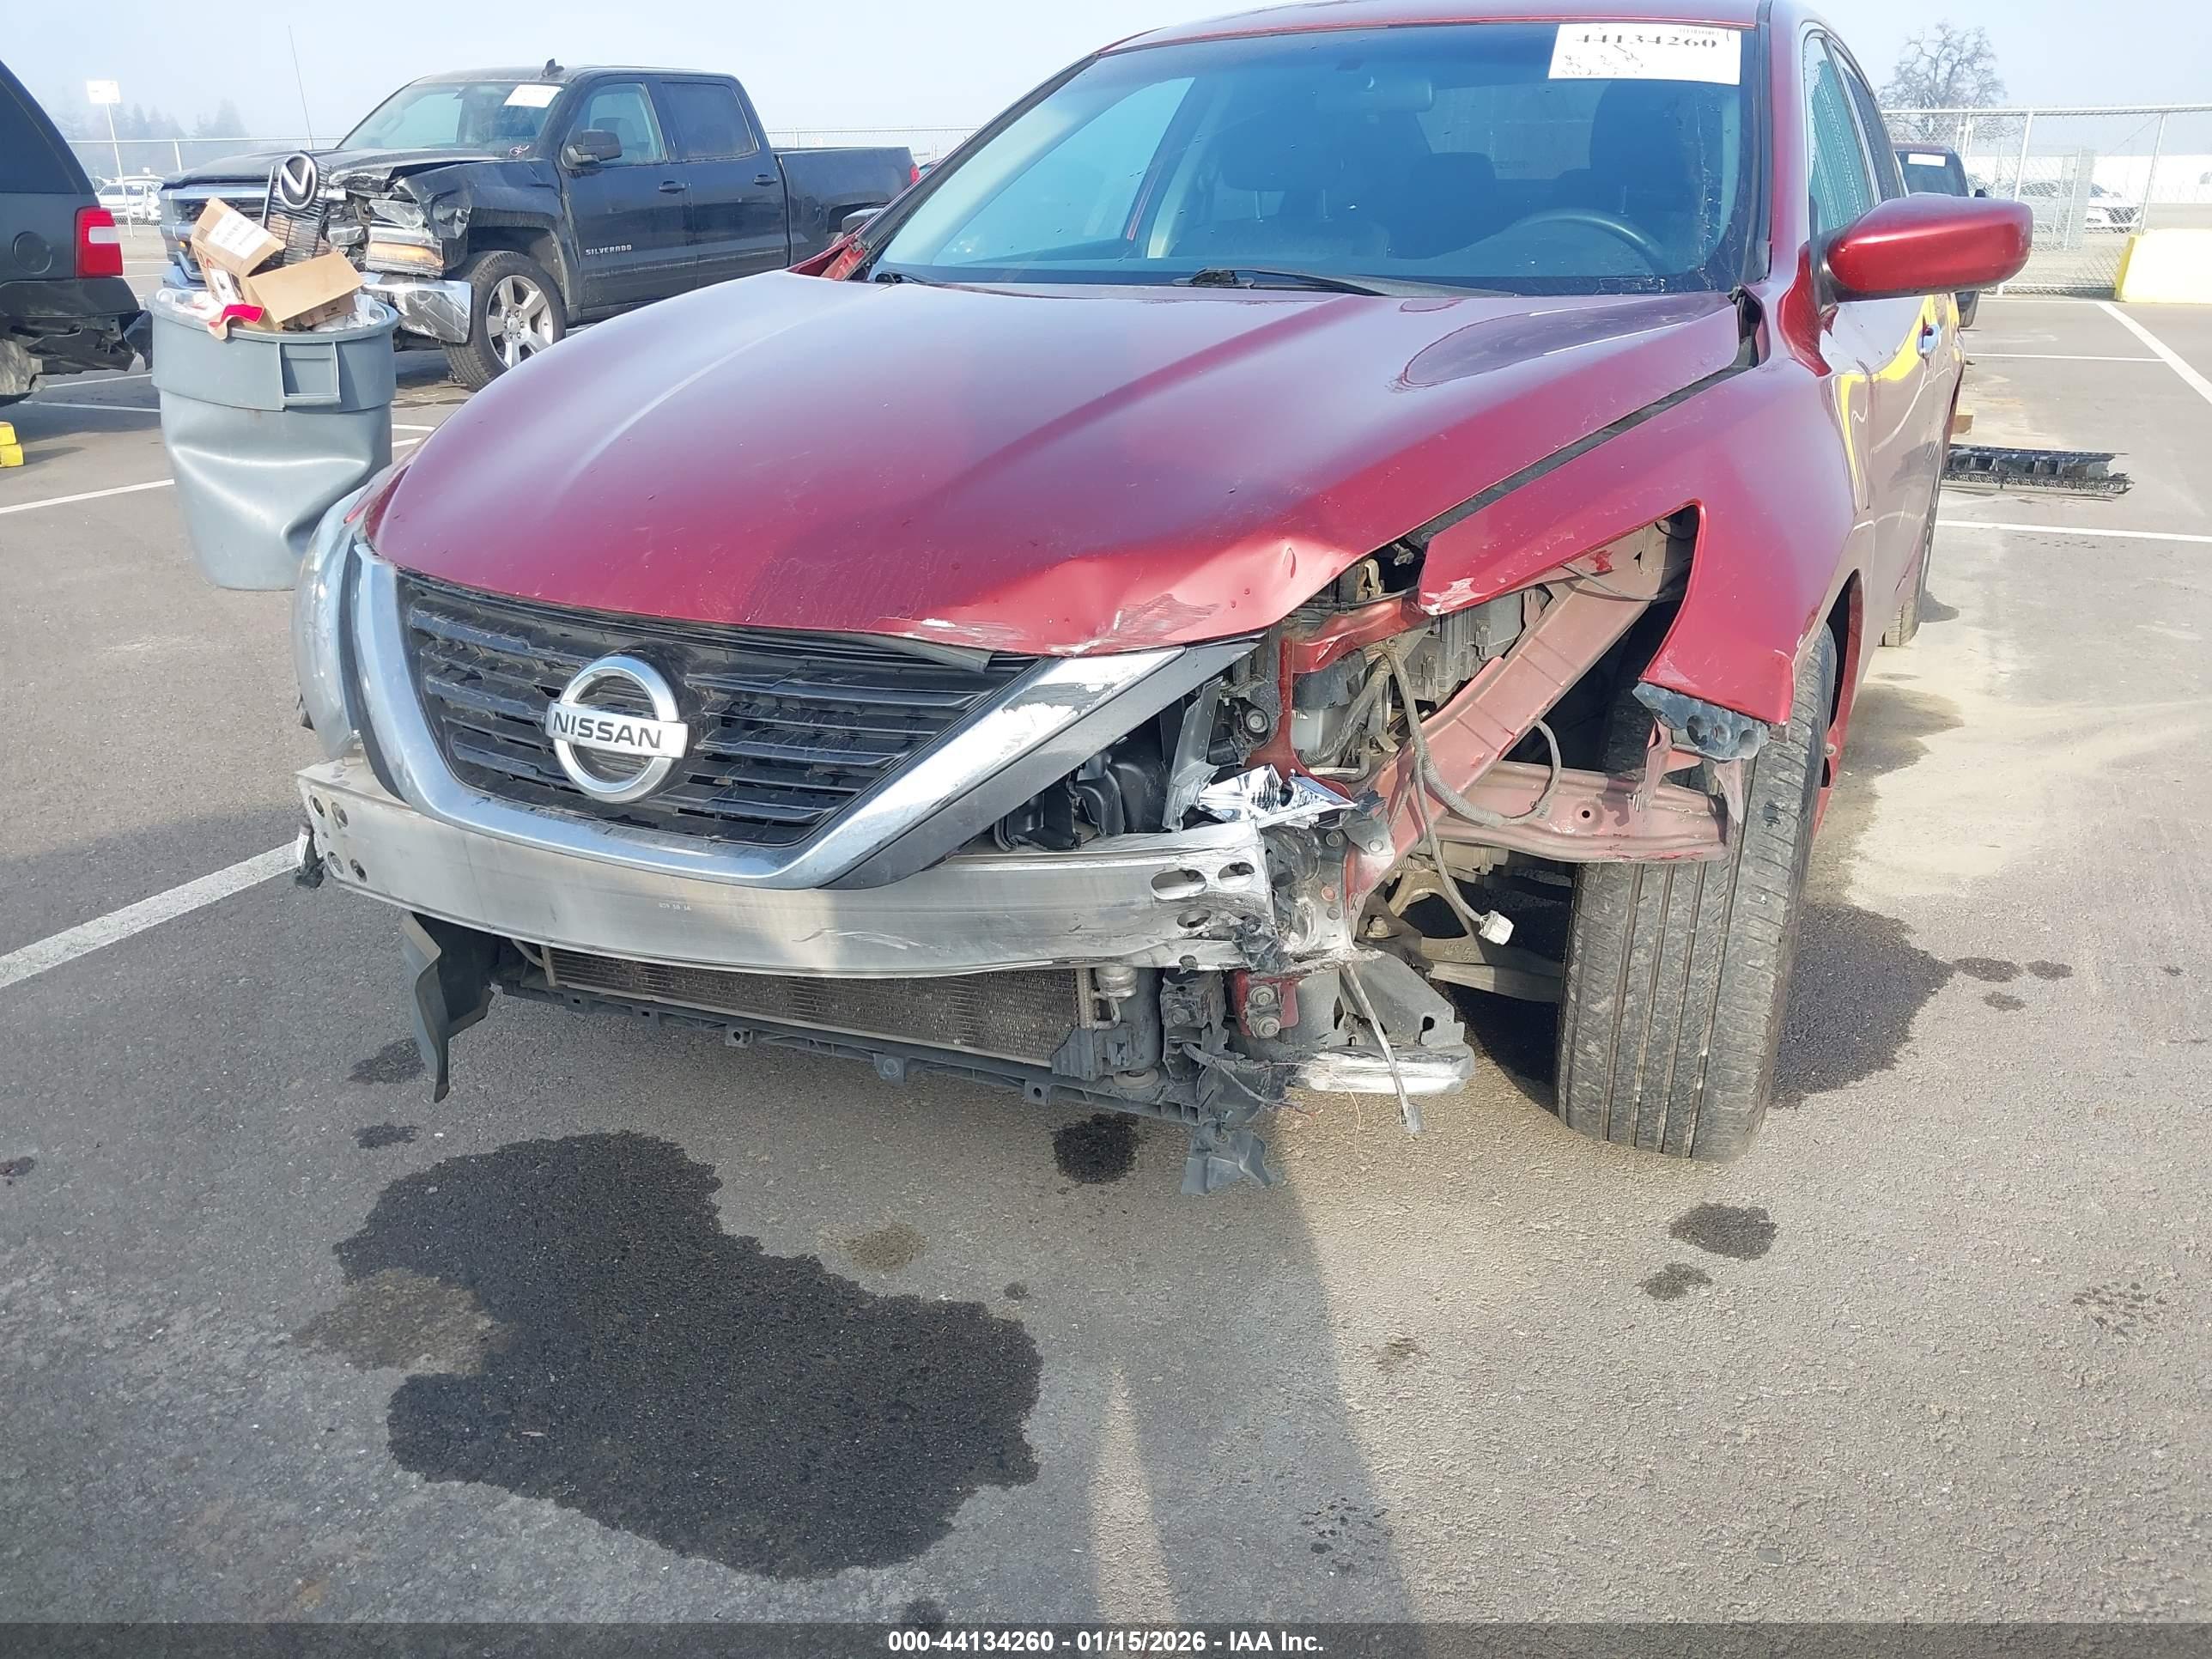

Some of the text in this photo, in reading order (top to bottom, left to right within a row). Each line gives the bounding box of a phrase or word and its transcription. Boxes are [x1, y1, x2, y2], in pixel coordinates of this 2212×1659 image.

[1576, 33, 1717, 48] 44134260
[585, 244, 632, 255] SILVERADO
[553, 711, 662, 749] NISSAN
